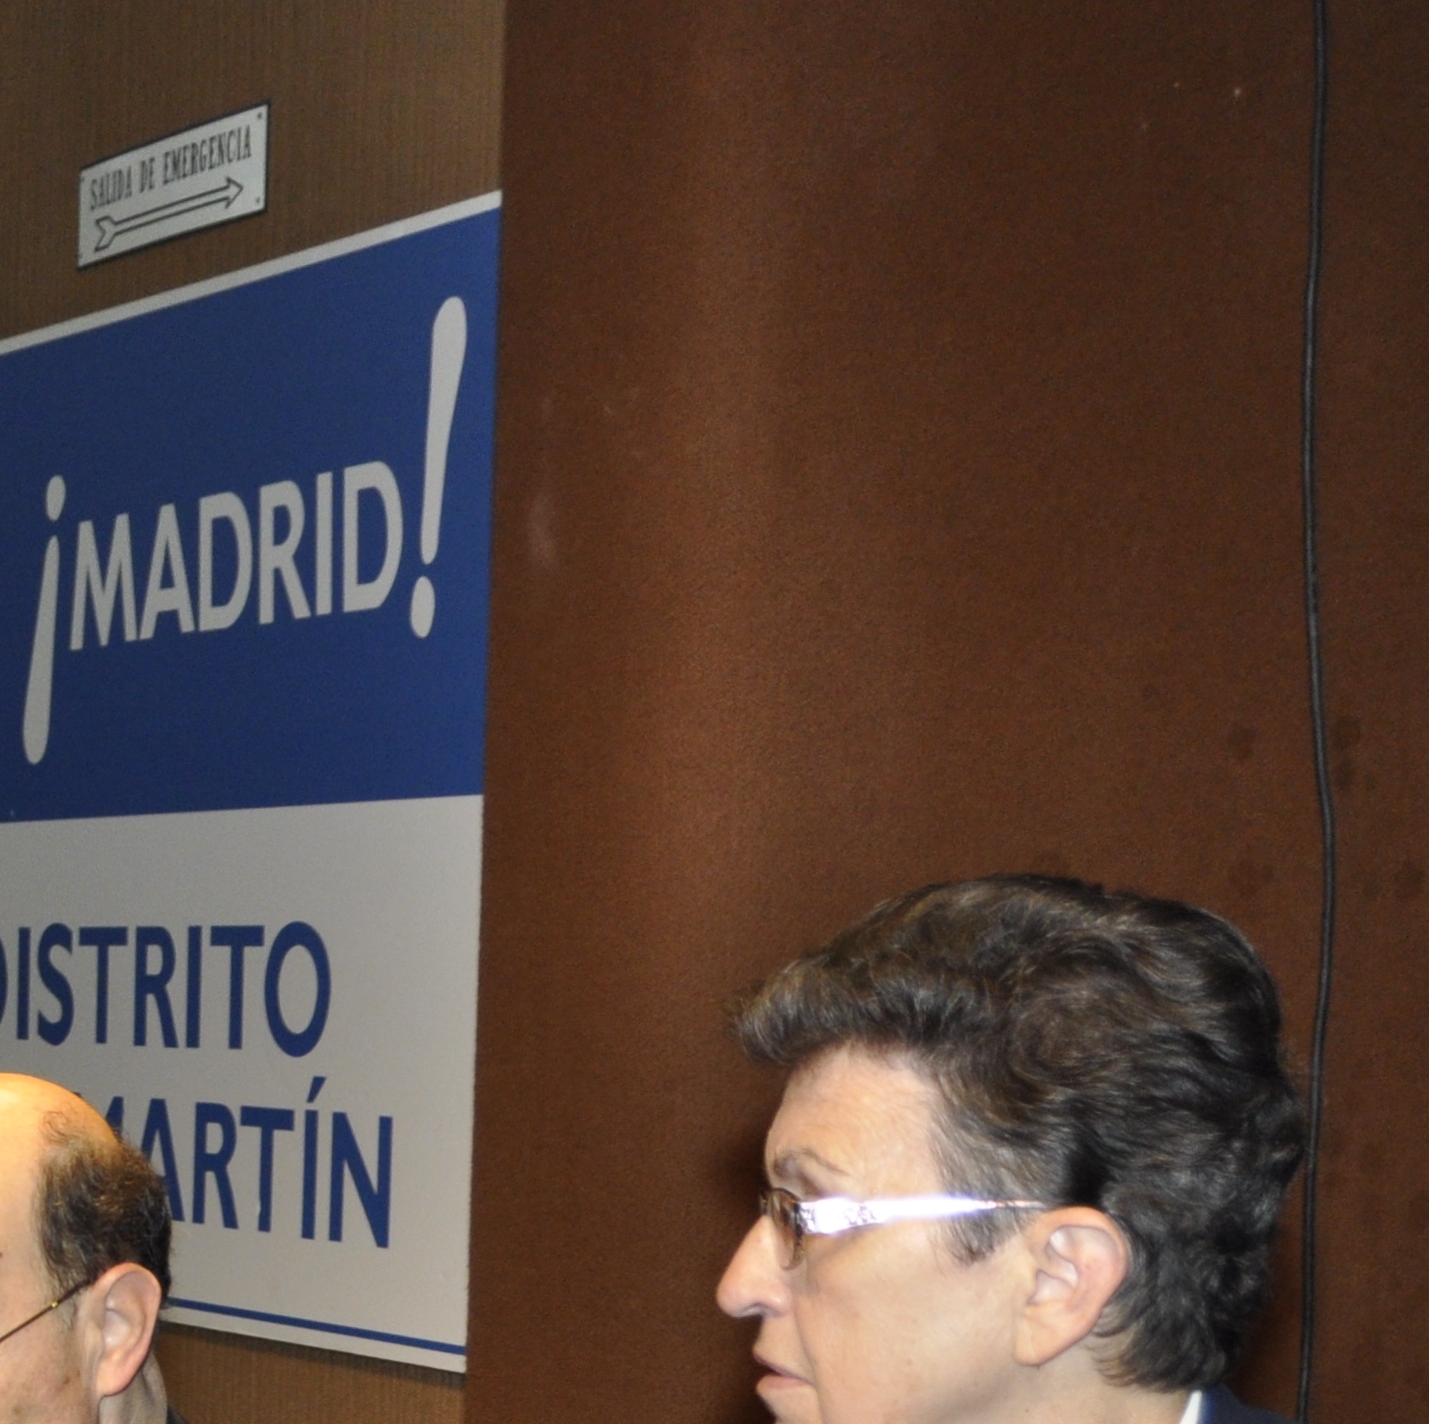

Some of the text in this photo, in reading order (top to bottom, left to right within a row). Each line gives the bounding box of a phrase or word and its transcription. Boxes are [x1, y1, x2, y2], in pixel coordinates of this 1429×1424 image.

[90, 125, 252, 212] SALIDA DE EMERGENCIA
[22, 296, 467, 764] ¡MADRID!
